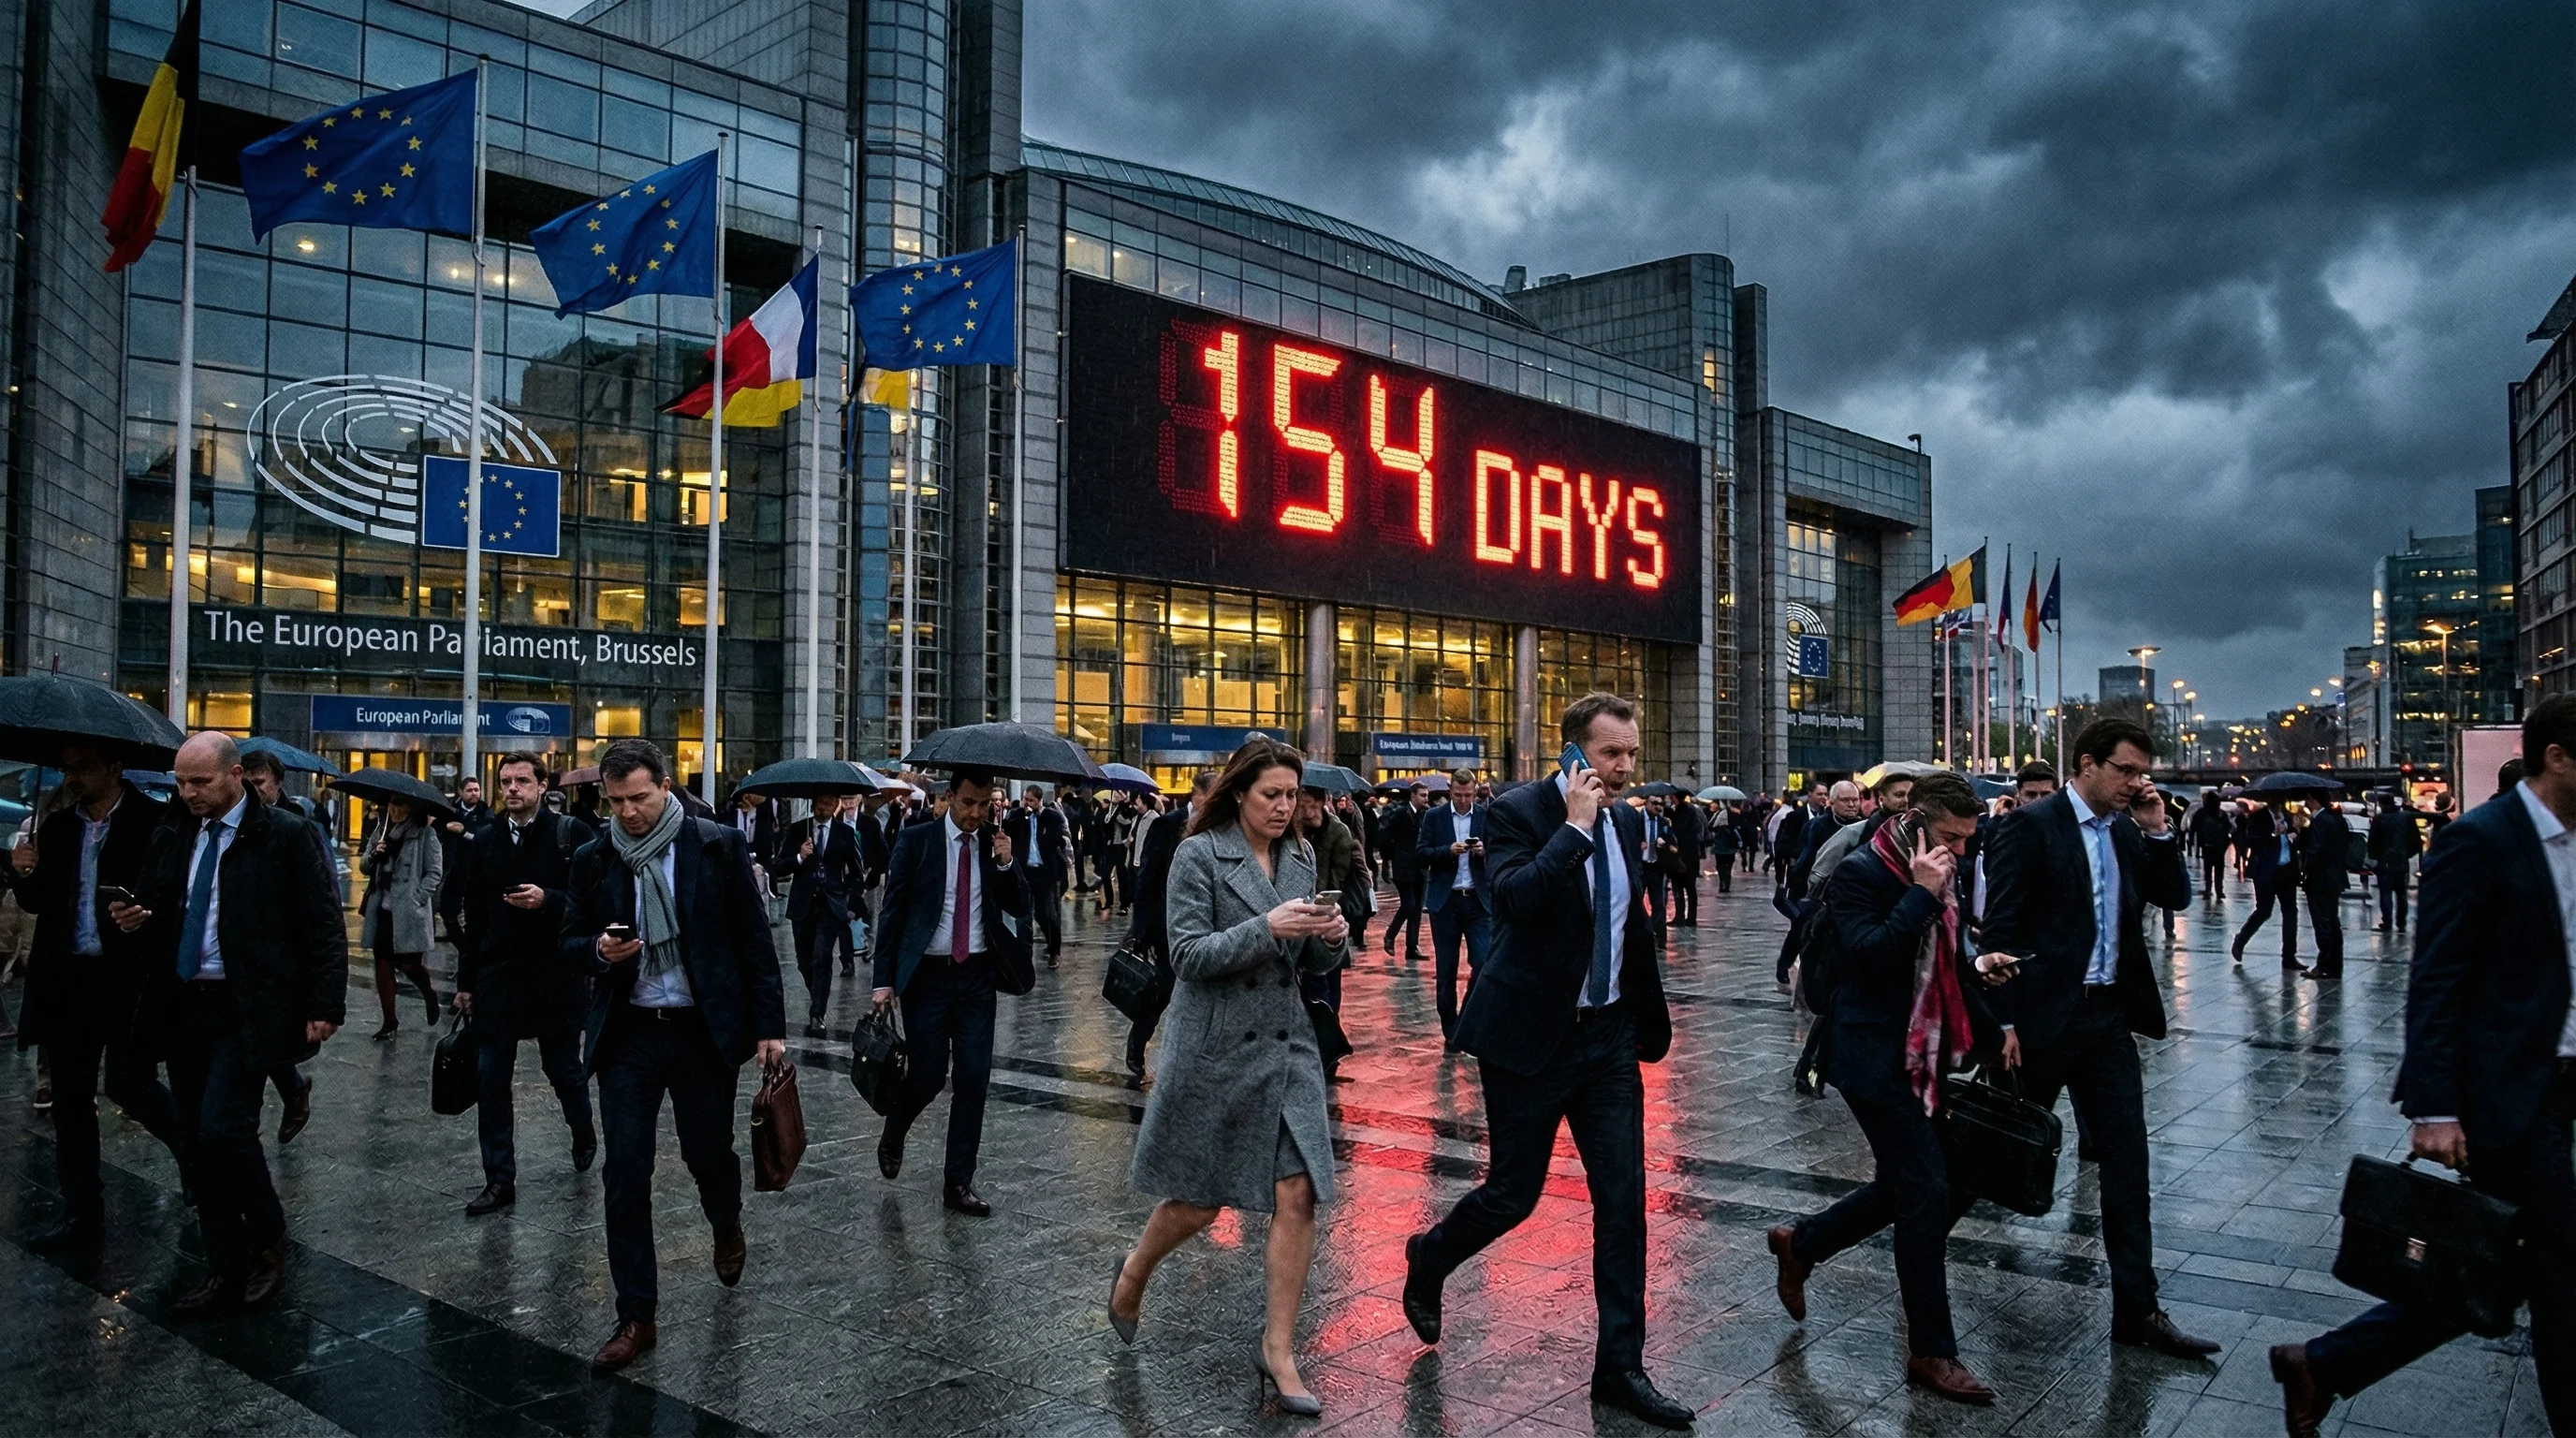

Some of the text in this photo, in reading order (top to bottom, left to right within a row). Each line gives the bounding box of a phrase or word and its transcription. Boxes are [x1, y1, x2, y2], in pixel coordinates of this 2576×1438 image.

[1204, 330, 1664, 588] 154 DAYS
[204, 610, 696, 667] The European Paiament, Brussels
[357, 707, 490, 727] European Parliant
